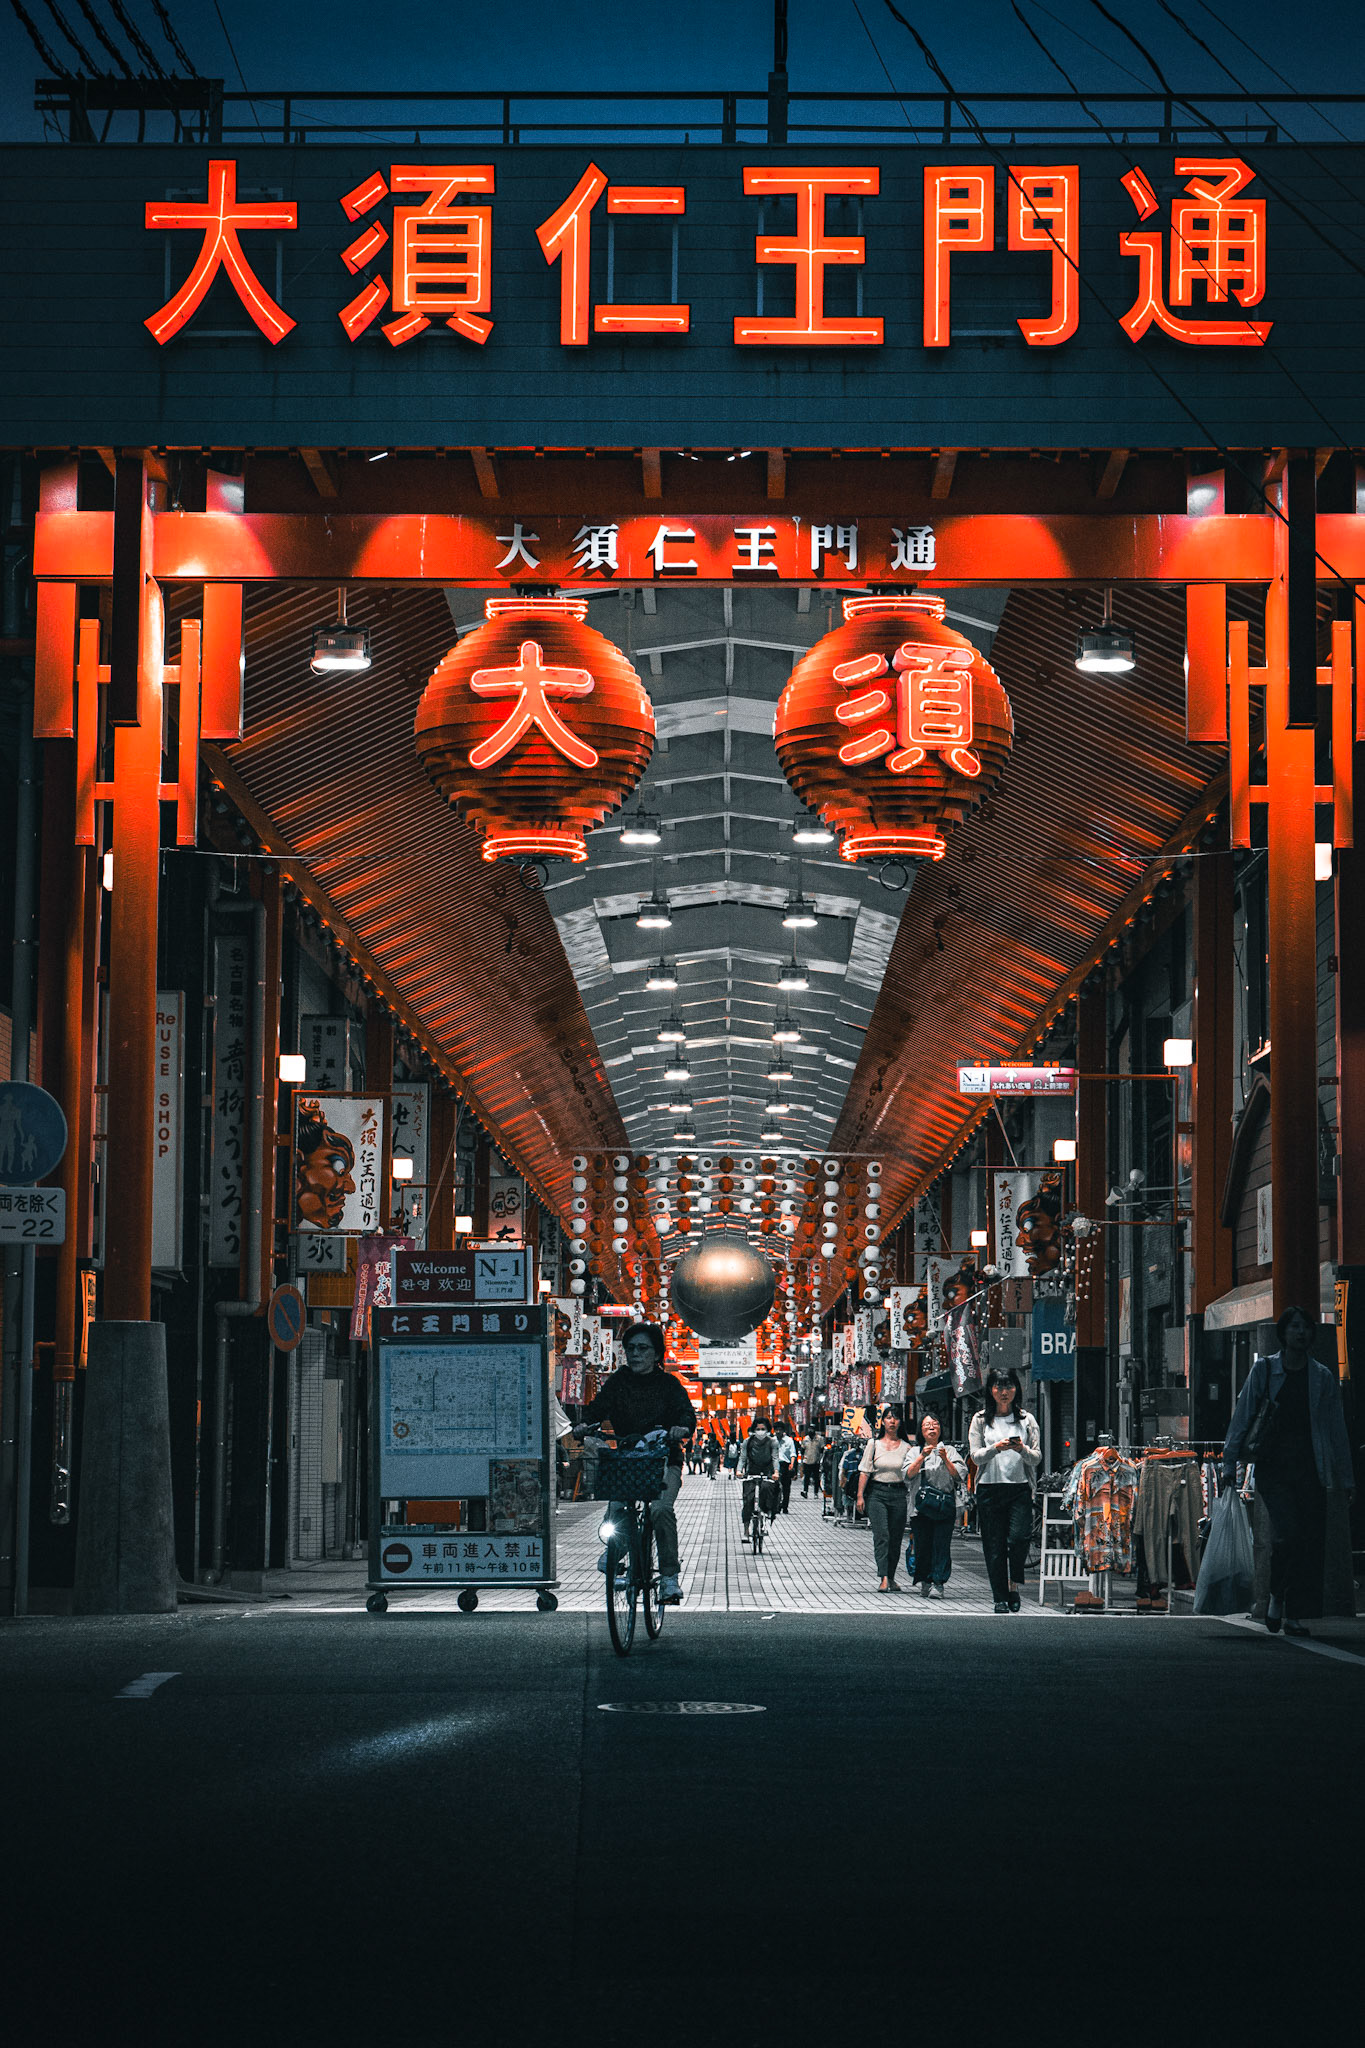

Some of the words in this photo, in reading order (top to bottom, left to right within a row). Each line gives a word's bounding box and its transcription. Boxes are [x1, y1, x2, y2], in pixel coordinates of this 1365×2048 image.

[144, 157, 1274, 348] 大須仁王門通
[495, 523, 937, 572] 大須仁王門通
[468, 640, 600, 770] 大
[832, 641, 981, 778] 須
[229, 948, 244, 1028] 名古屋名物
[962, 1072, 987, 1083] N-1
[159, 1093, 171, 1158] SHOP
[359, 1108, 378, 1226] 大須仁王門通り
[999, 1179, 1013, 1275] 大須仁王門通り
[401, 1278, 430, 1291] 환영
[410, 1262, 467, 1275] Welcome
[438, 1278, 472, 1292] 欢迎
[478, 1258, 522, 1277] N-1
[391, 1313, 528, 1333] 仁王門通り
[422, 1542, 541, 1558] 車両進入禁止
